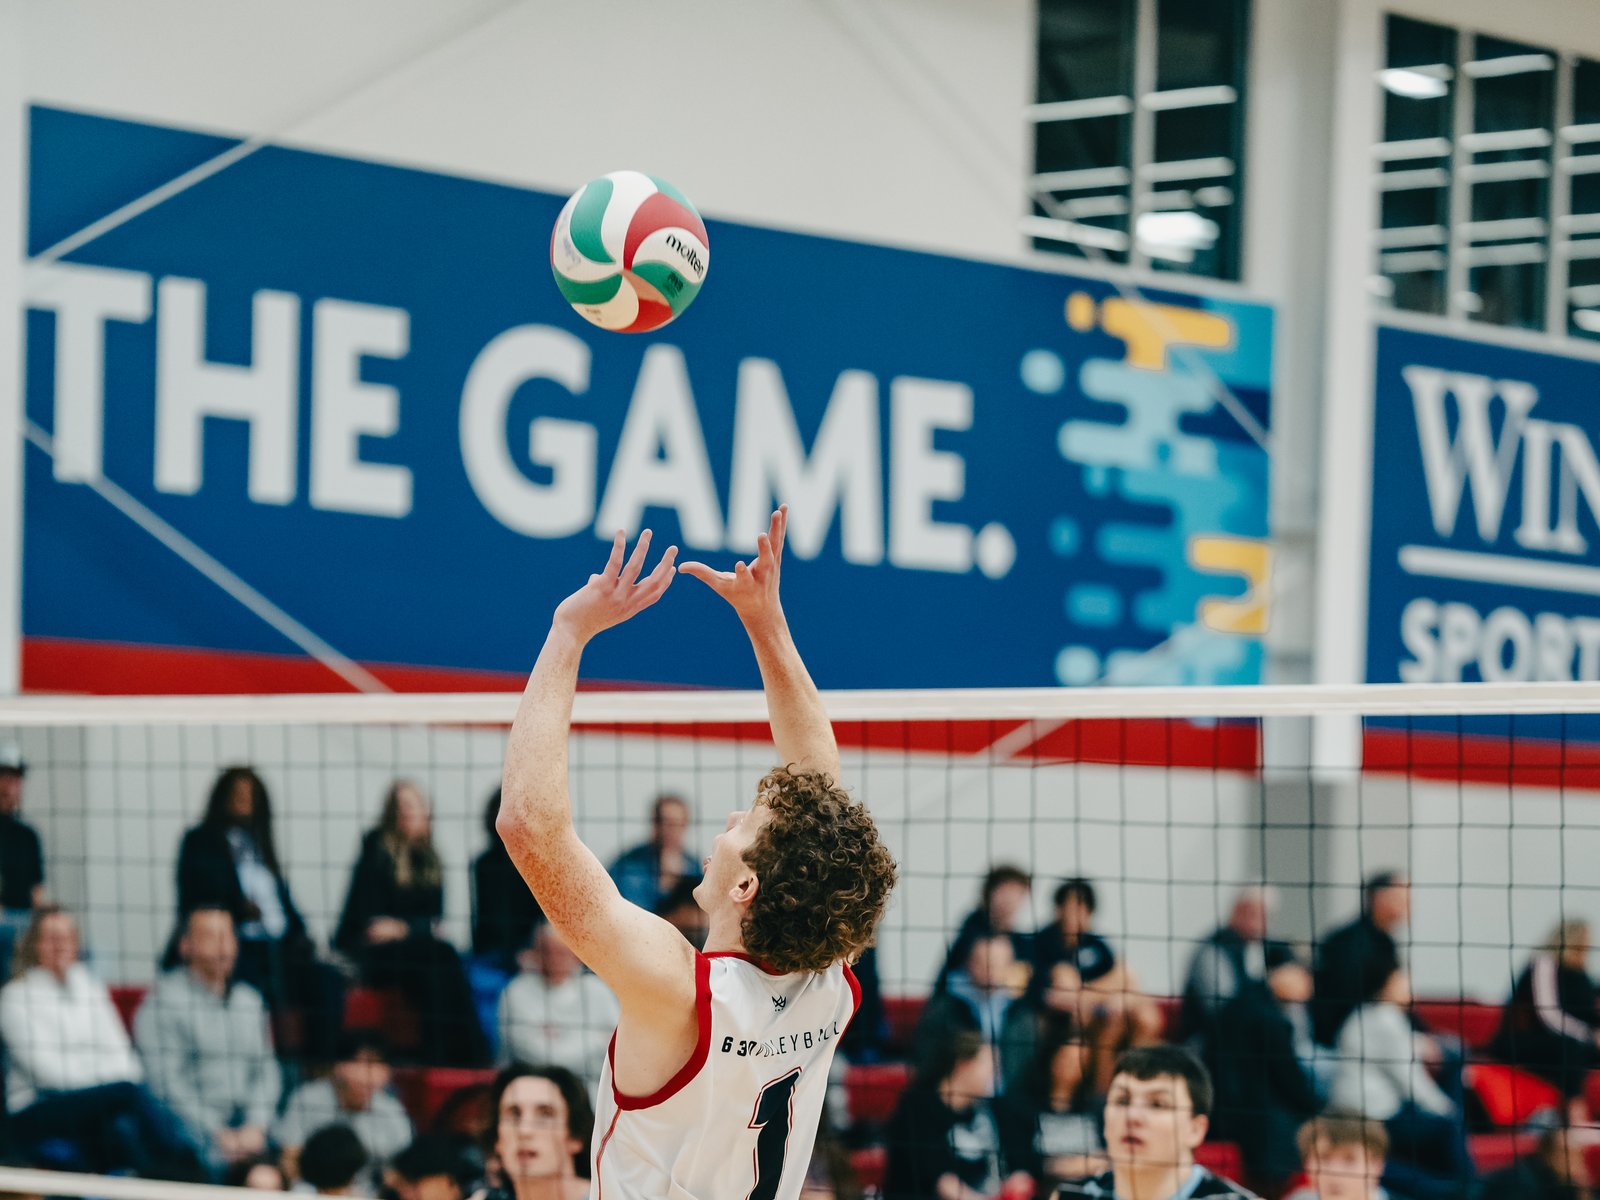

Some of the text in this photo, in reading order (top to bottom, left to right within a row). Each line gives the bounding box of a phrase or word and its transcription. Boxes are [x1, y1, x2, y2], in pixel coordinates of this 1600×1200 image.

[665, 234, 704, 278] molten
[24, 260, 1017, 579] THE GAME.
